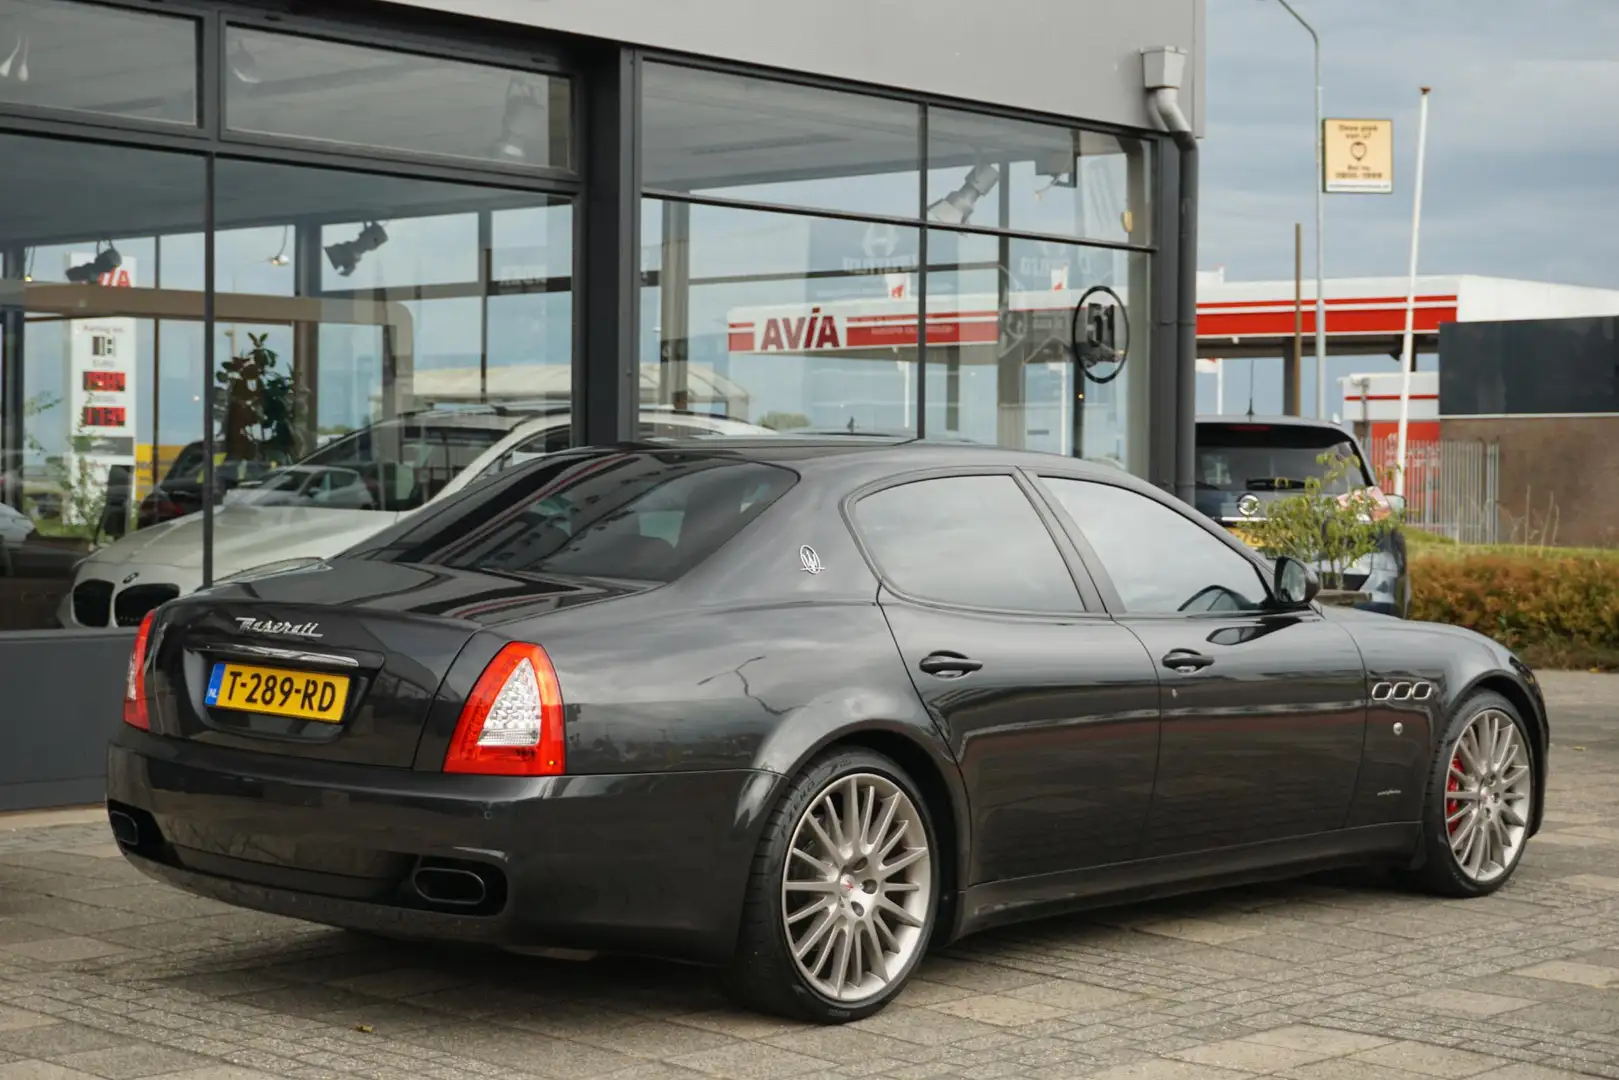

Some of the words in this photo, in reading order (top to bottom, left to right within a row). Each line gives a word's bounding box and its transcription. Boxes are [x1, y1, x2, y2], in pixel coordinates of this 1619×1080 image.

[761, 307, 840, 350] AVIA
[235, 616, 324, 638] Maserati
[208, 688, 217, 698] NL
[227, 670, 337, 712] T-289-RD
